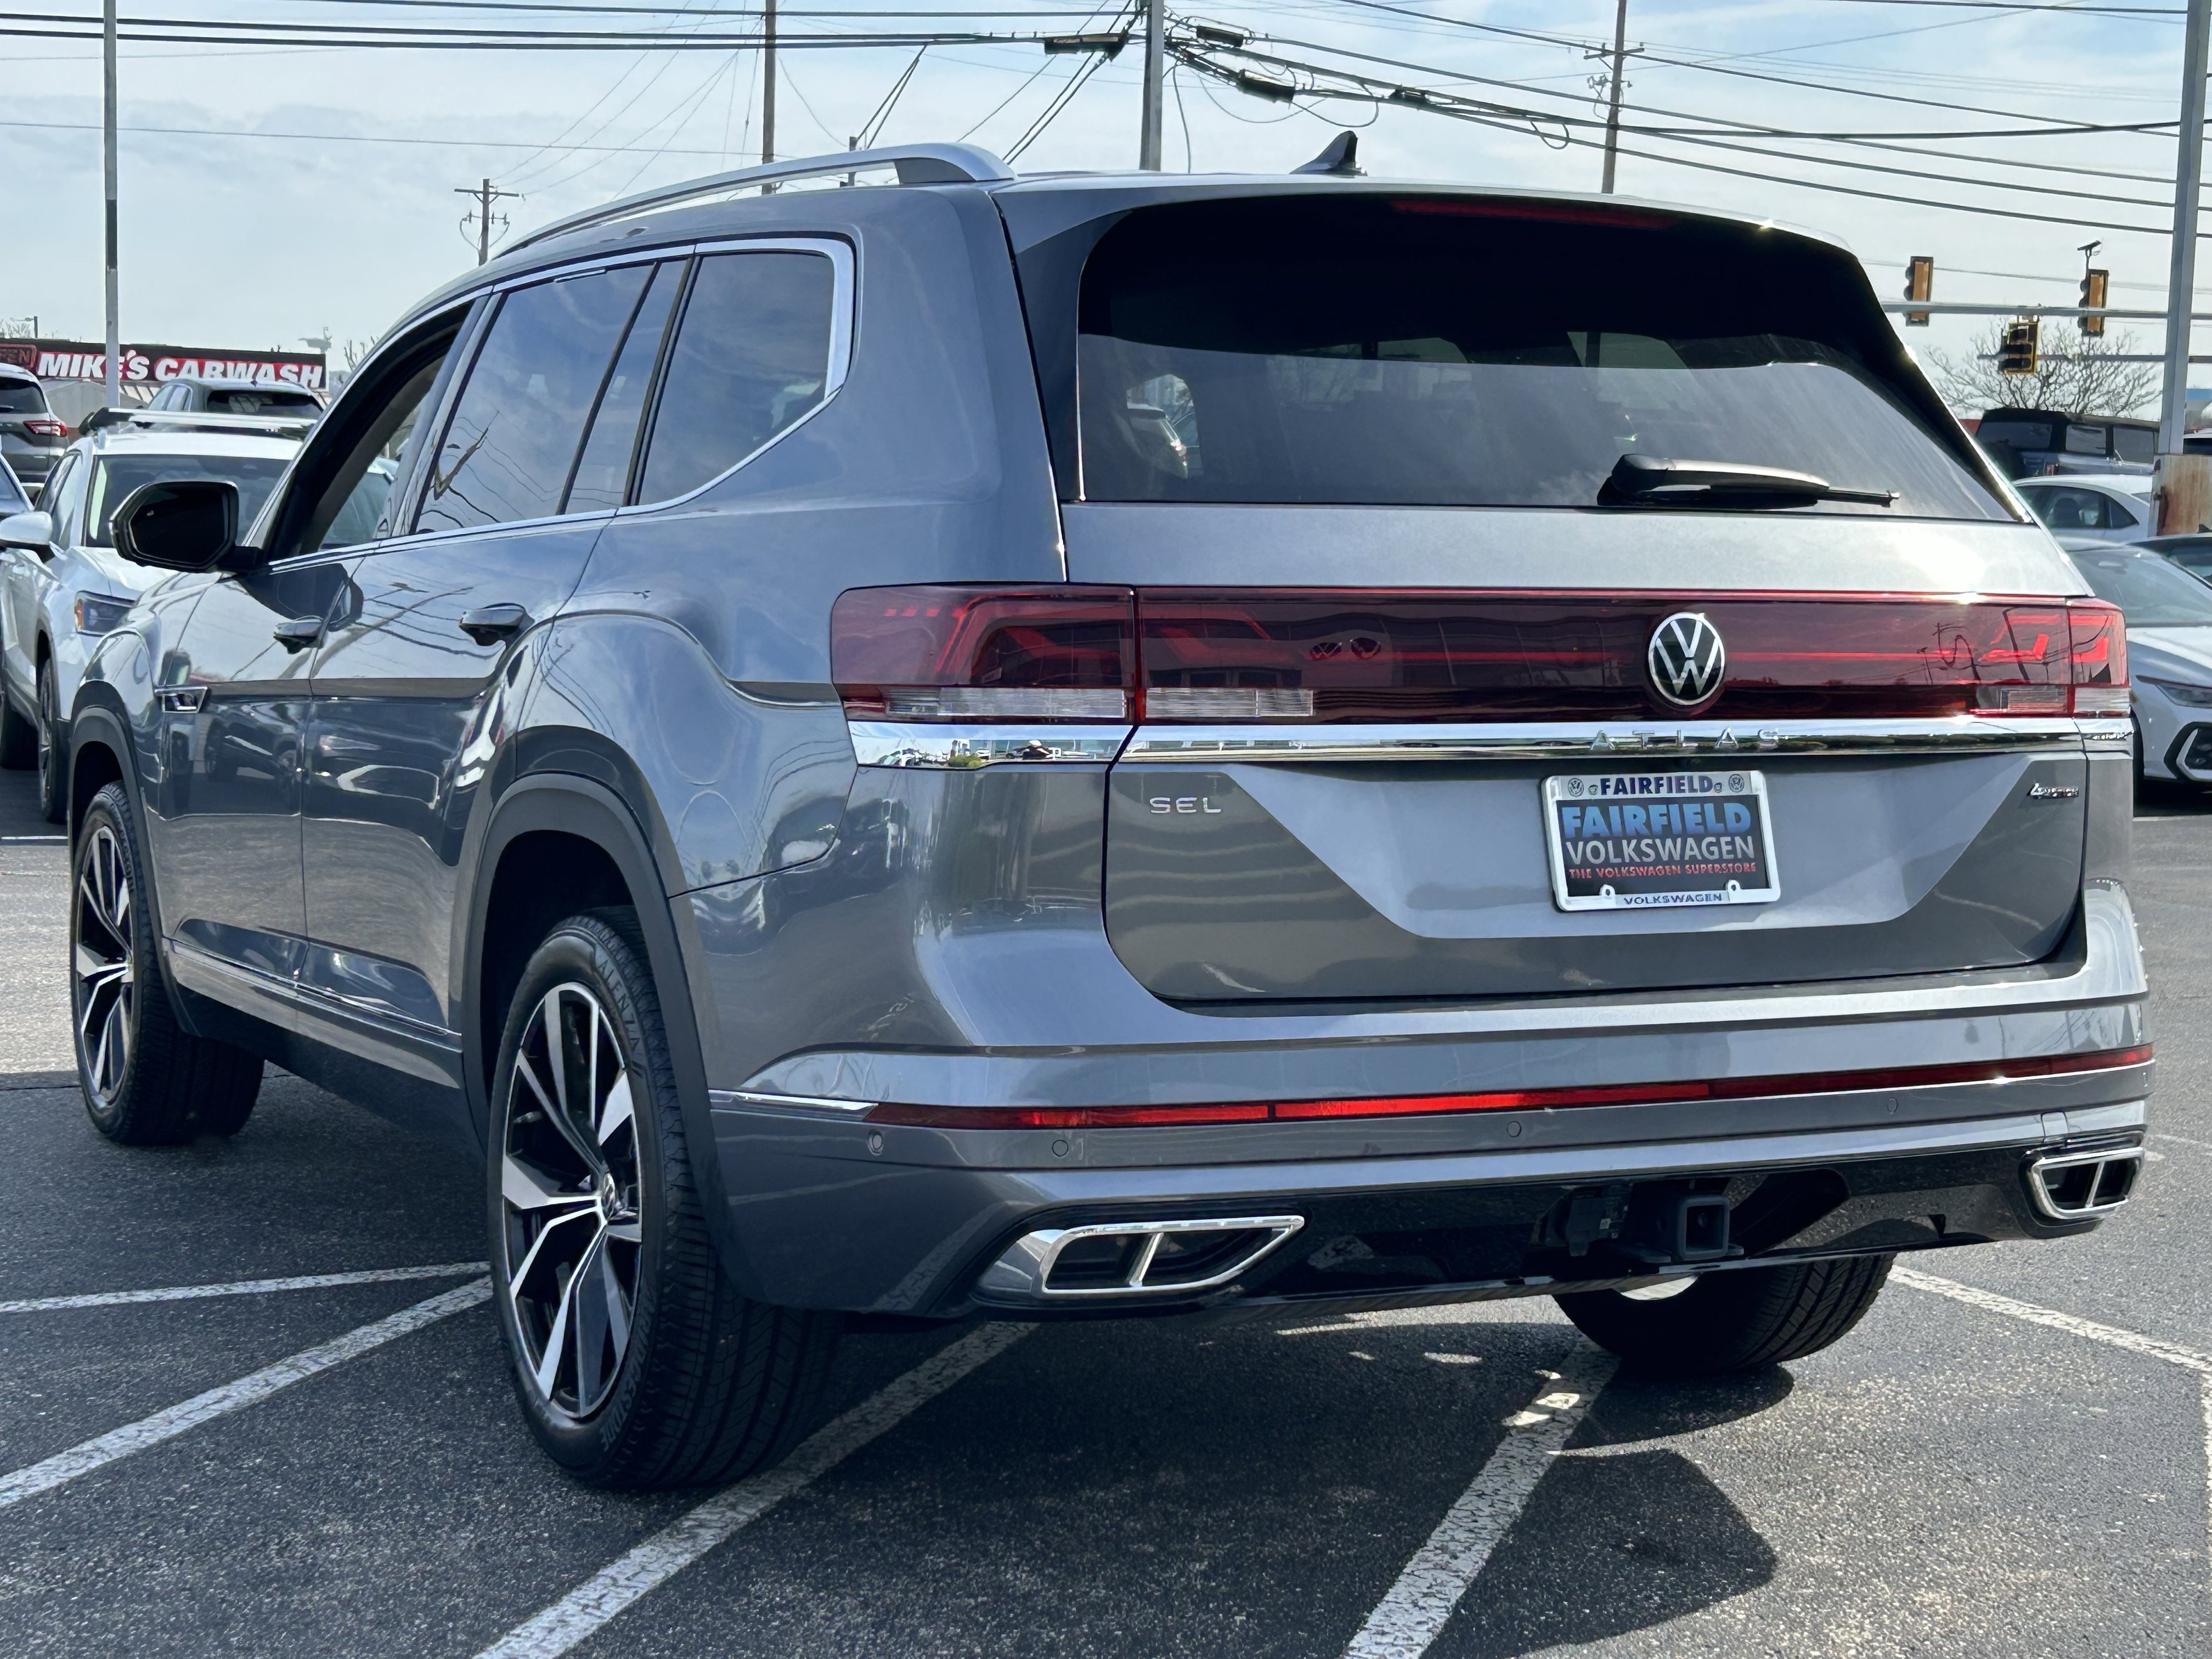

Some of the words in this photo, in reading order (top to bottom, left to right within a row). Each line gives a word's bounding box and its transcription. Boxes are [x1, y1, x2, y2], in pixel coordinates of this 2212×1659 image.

[155, 358, 323, 388] CARWASH
[1590, 727, 1779, 750] ATLAS
[1600, 775, 1713, 795] FAIRFIELD
[1149, 797, 1221, 814] SEL
[1561, 803, 1751, 838] FAIRFIELD
[1566, 836, 1754, 865] VOLKSWAGEN
[1569, 868, 1592, 879] THE
[1596, 864, 1681, 878] VOLKSWAGEN
[1685, 862, 1756, 874] SUPERSTORE
[1623, 893, 1722, 905] VOLKSWAGEN
